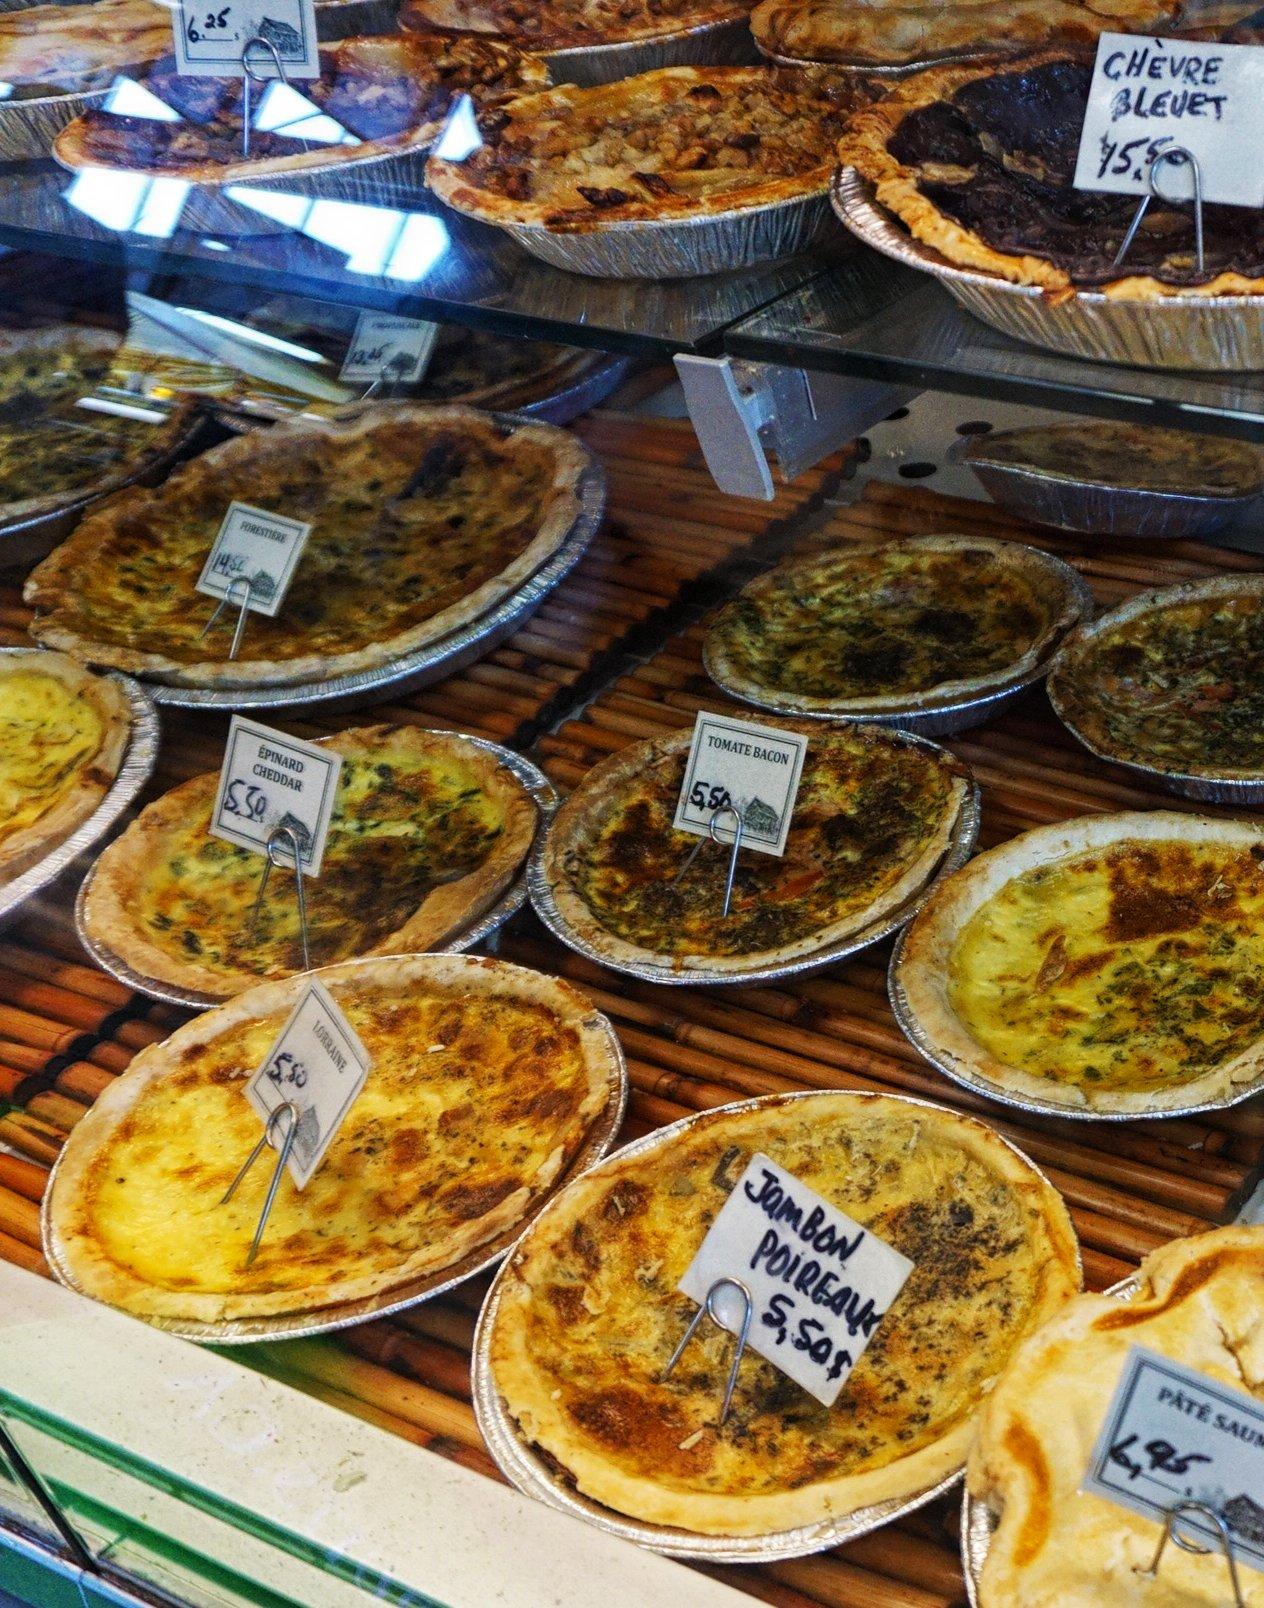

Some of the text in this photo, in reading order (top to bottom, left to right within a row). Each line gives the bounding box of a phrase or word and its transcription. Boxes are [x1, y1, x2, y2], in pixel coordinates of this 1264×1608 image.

[1103, 39, 1223, 85] CHÈVRE
[1111, 86, 1228, 122] BLEUET
[257, 745, 305, 773] ÉPINARD
[708, 735, 789, 765] TOMATE BACON
[252, 763, 303, 792] CHEDDAR
[312, 1020, 348, 1074] LORRAINE
[1157, 1386, 1212, 1424] PÂTÉ
